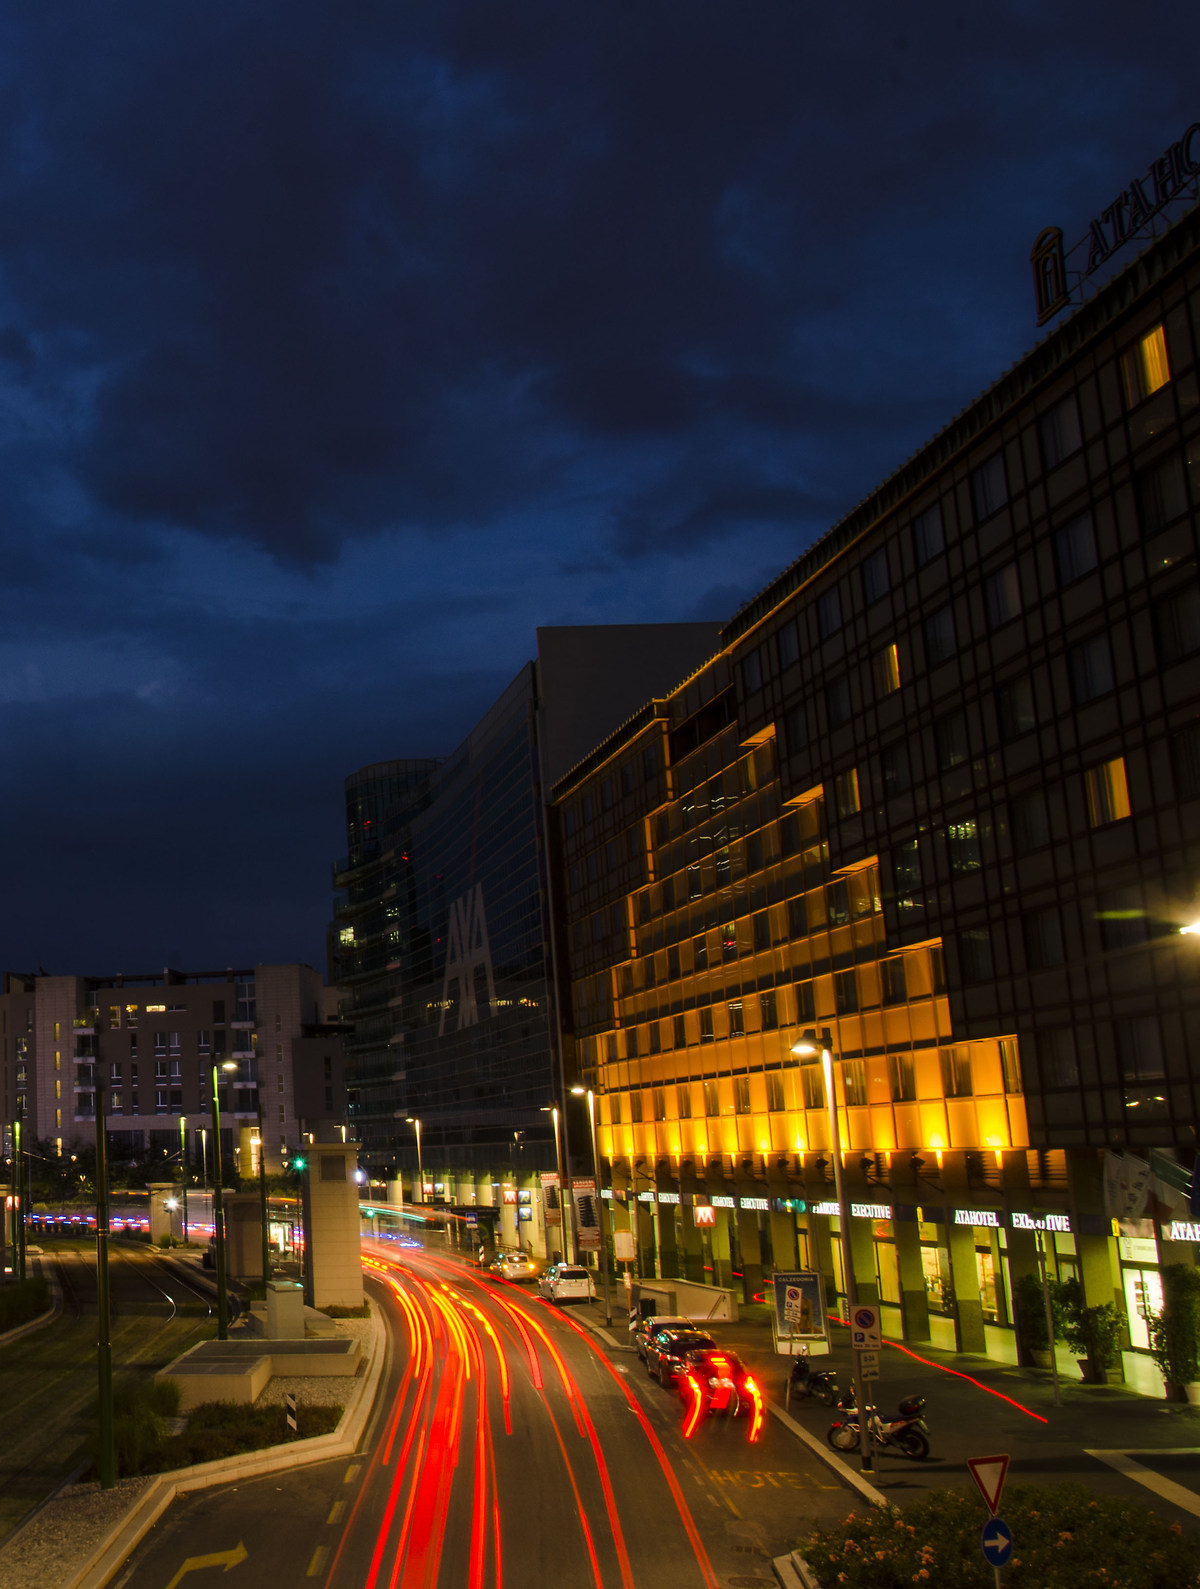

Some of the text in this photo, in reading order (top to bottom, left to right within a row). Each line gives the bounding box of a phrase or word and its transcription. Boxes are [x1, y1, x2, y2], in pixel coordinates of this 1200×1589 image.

[740, 1197, 769, 1211] EXECUTIVE
[851, 1203, 891, 1219] EXECUTIVE
[955, 1209, 1000, 1227] ATAHOTEL
[709, 1470, 841, 1488] HOTEL
